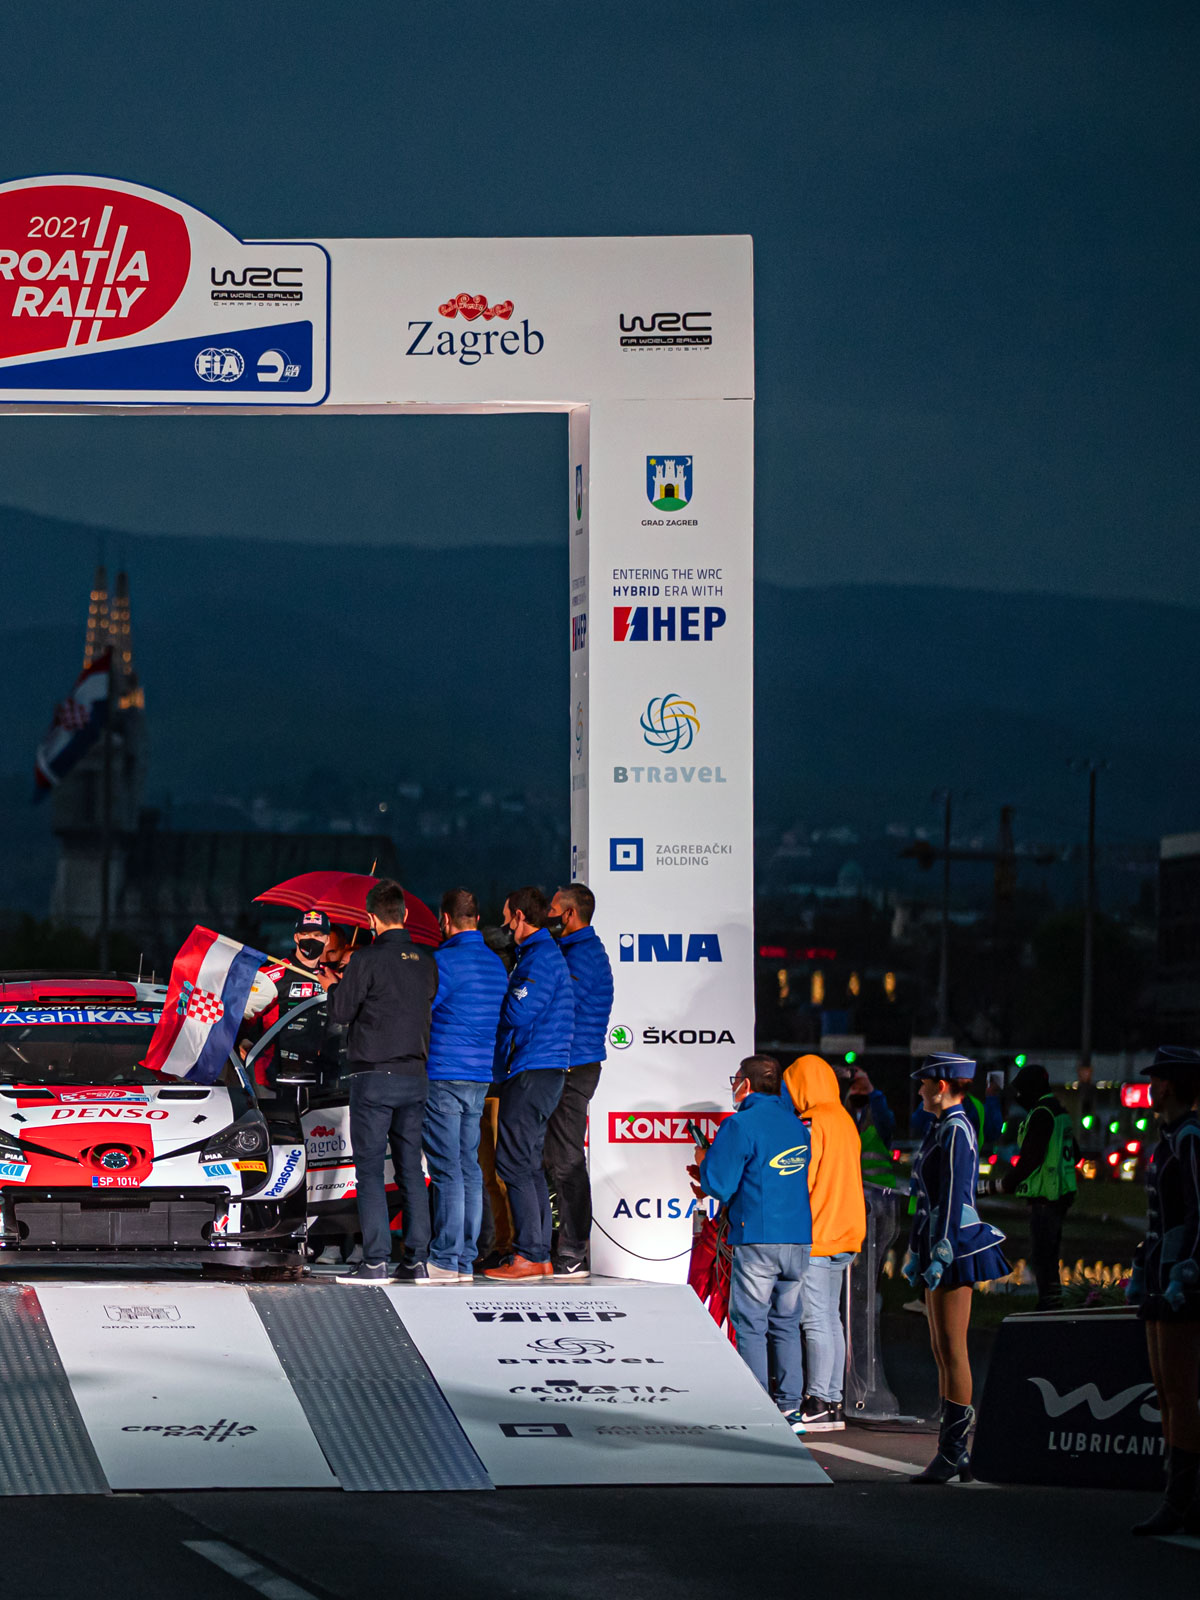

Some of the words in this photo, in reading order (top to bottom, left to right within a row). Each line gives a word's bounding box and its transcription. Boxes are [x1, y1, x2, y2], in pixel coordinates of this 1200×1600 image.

[27, 216, 91, 238] 2021
[210, 267, 303, 287] WRC
[12, 286, 146, 320] RALLY
[619, 312, 712, 332] WRC
[405, 319, 545, 365] Zagreb
[641, 519, 664, 527] GRAD
[666, 519, 698, 527] ZAGREB
[613, 569, 669, 580] ENTERING
[672, 569, 694, 580] THE
[697, 569, 723, 580] WRC
[613, 586, 660, 597] HYBRID
[664, 586, 688, 597] ERA
[691, 586, 723, 597] WITH
[652, 606, 727, 642] HEP
[656, 842, 733, 854] ZAGREBAČKI
[656, 856, 710, 866] HOLDING
[643, 1026, 736, 1045] ŠKODA
[51, 1108, 169, 1120] DENSO
[4, 1153, 24, 1161] PIAA
[204, 1153, 223, 1161] PIAA
[264, 1149, 302, 1198] Panasonic
[99, 1177, 113, 1185] SP
[116, 1177, 138, 1185] 1014
[315, 1183, 346, 1191] GAZOO
[525, 1312, 628, 1322] HEP
[509, 1386, 689, 1395] CROATIA
[121, 1420, 258, 1432] CROATIA
